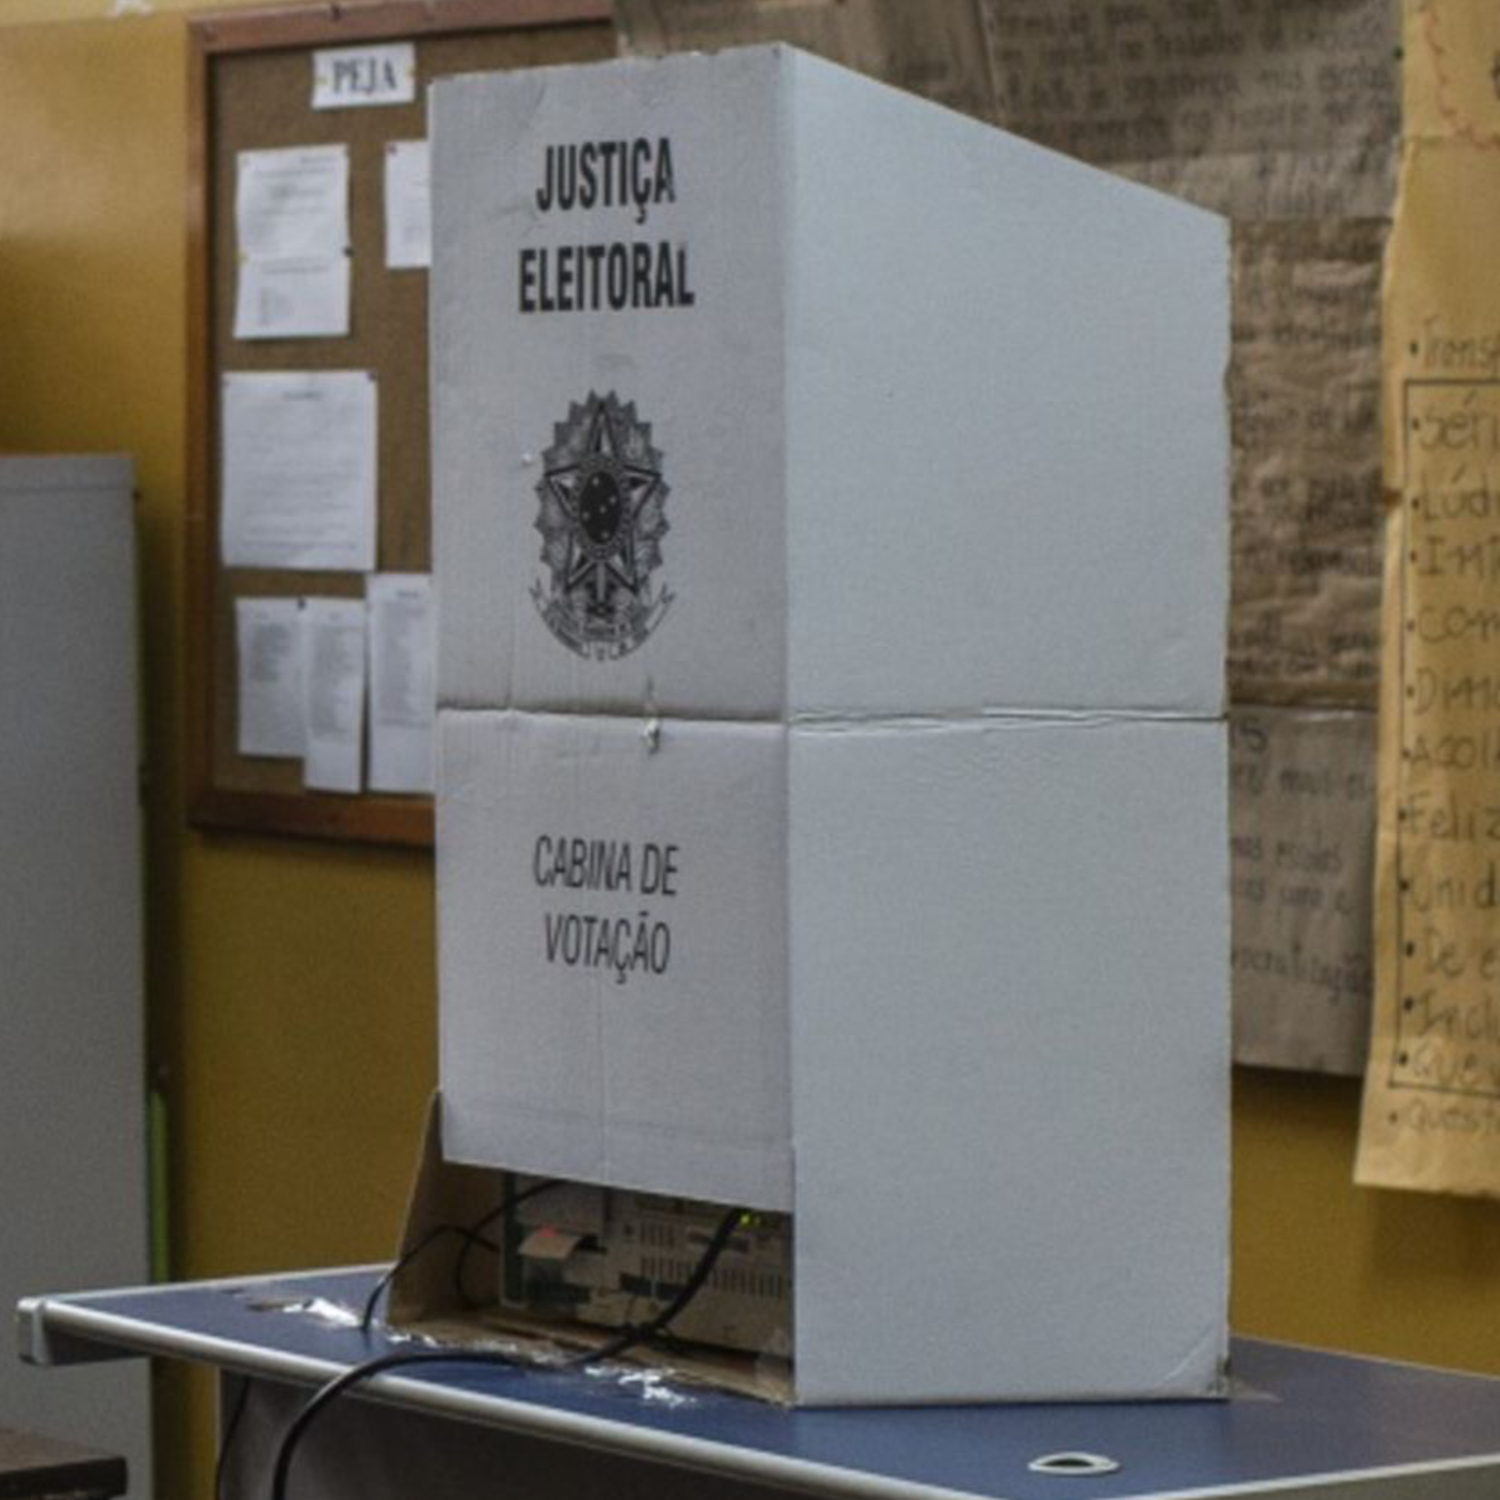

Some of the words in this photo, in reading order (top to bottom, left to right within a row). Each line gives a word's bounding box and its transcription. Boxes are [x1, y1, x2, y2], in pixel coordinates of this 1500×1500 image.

[333, 58, 396, 93] PEJA
[536, 137, 675, 225] JUSTIÇA
[520, 241, 695, 313] ELEITORAL
[534, 835, 631, 891] CABINA
[640, 843, 678, 896] DE
[546, 911, 670, 984] VOTAÇÃO
